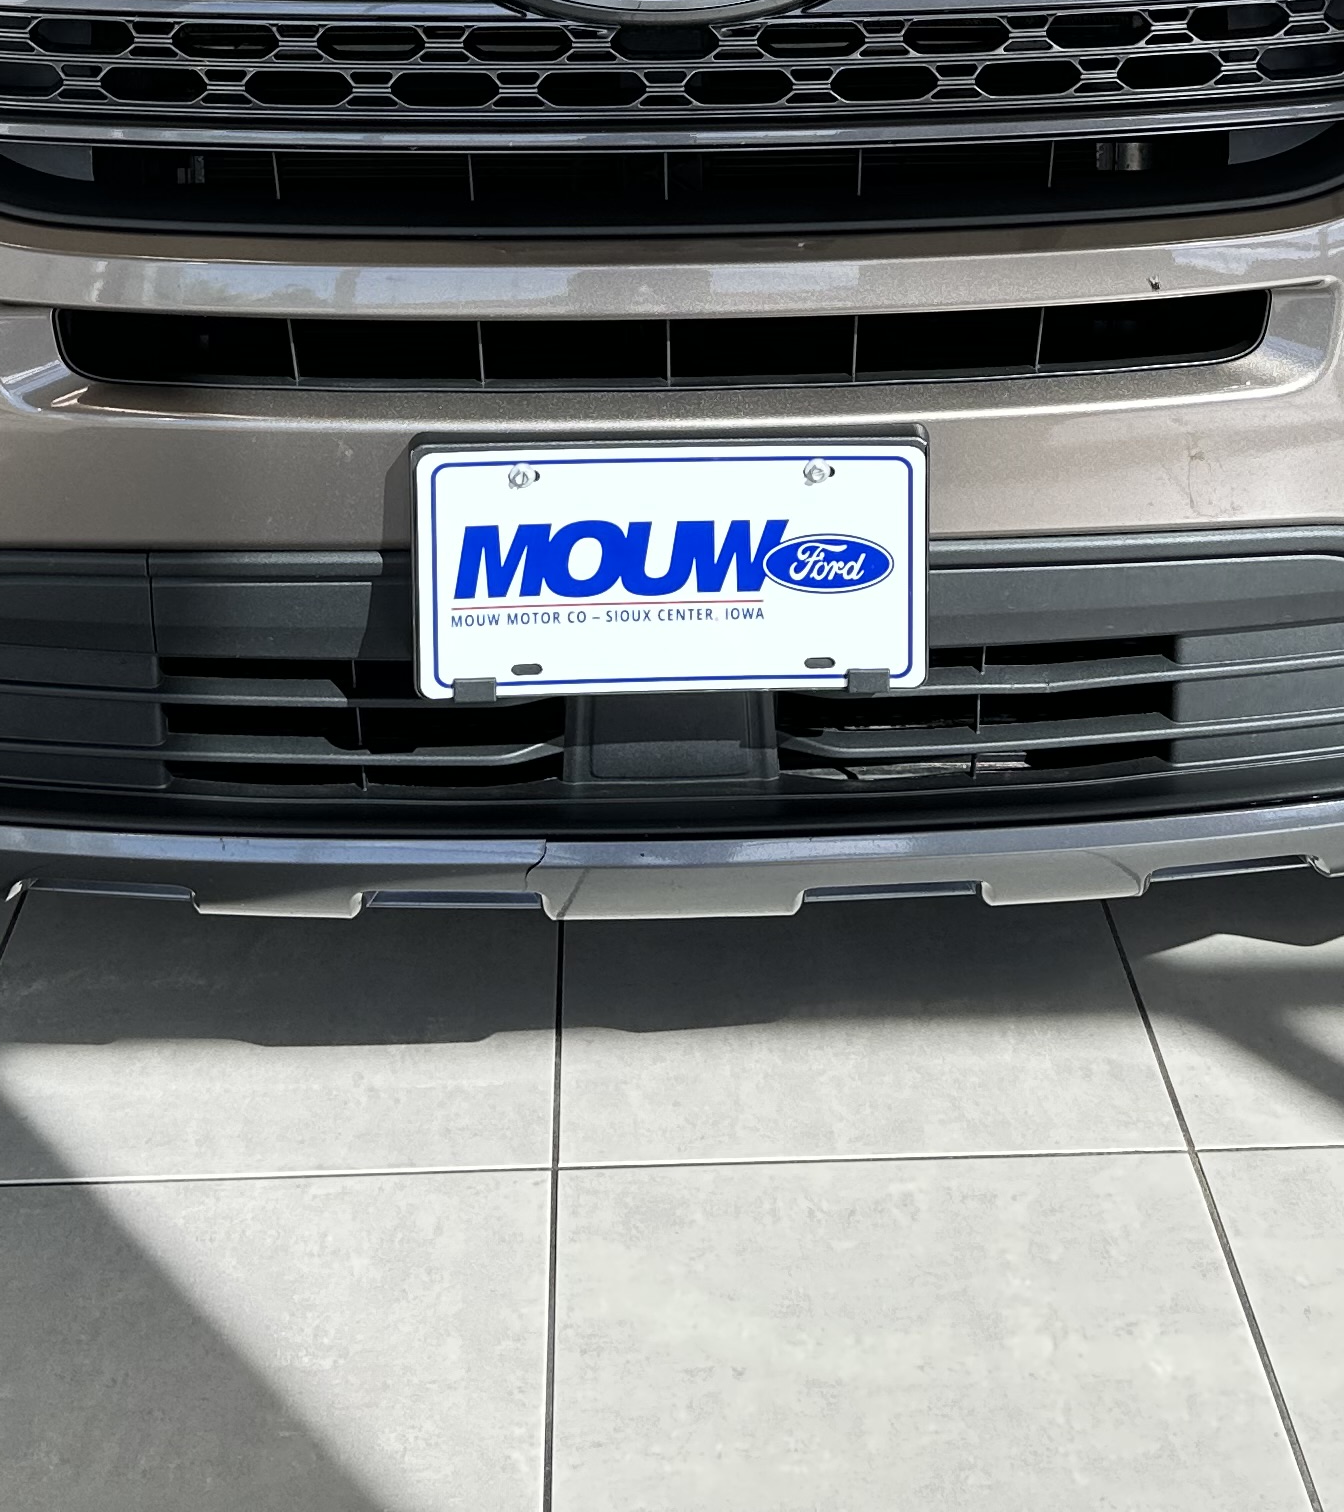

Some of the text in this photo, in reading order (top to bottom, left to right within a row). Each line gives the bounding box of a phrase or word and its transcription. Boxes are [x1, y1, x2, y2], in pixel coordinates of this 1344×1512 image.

[453, 519, 866, 600] MOUW Ford
[451, 613, 501, 628] MOUW
[507, 612, 562, 626] MOTOR
[567, 610, 587, 624] CO
[605, 609, 652, 623] SIOUX
[725, 607, 766, 621] IOWA
